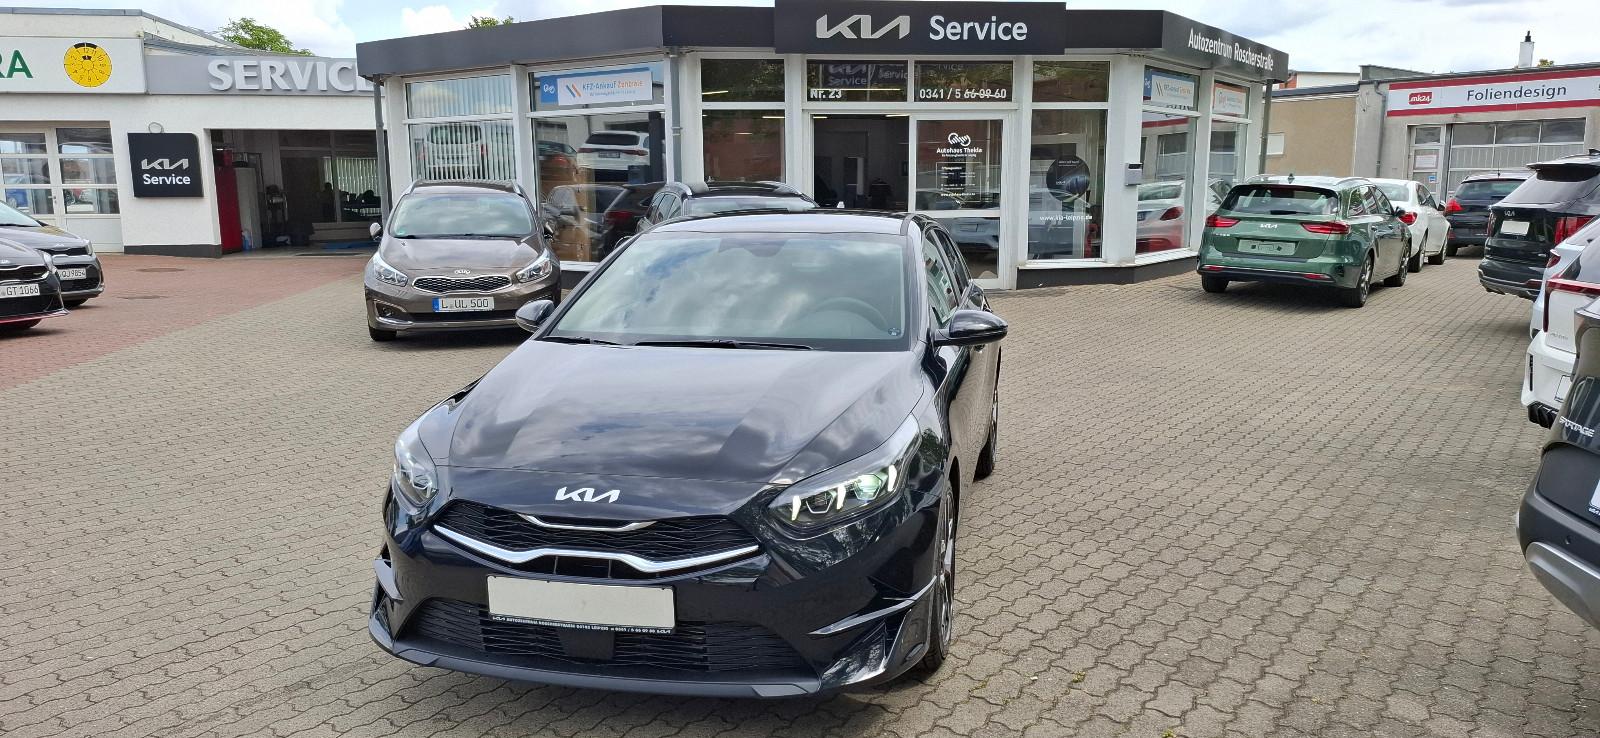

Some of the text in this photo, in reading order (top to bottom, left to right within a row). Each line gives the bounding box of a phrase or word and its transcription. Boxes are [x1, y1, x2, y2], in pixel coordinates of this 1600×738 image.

[816, 14, 1028, 41] KIA Service
[1188, 27, 1274, 72] Autozentrum Roscherstraße
[0, 49, 33, 78] A
[828, 89, 842, 99] 23
[919, 89, 944, 99] 0341
[947, 89, 953, 100] /
[955, 89, 961, 99] 5
[1466, 84, 1567, 102] Foliendesign
[141, 158, 189, 170] KIA
[142, 173, 191, 185] Service
[6, 286, 39, 296] GT 1066
[441, 298, 489, 309] L UL 500
[555, 486, 621, 503] KIA
